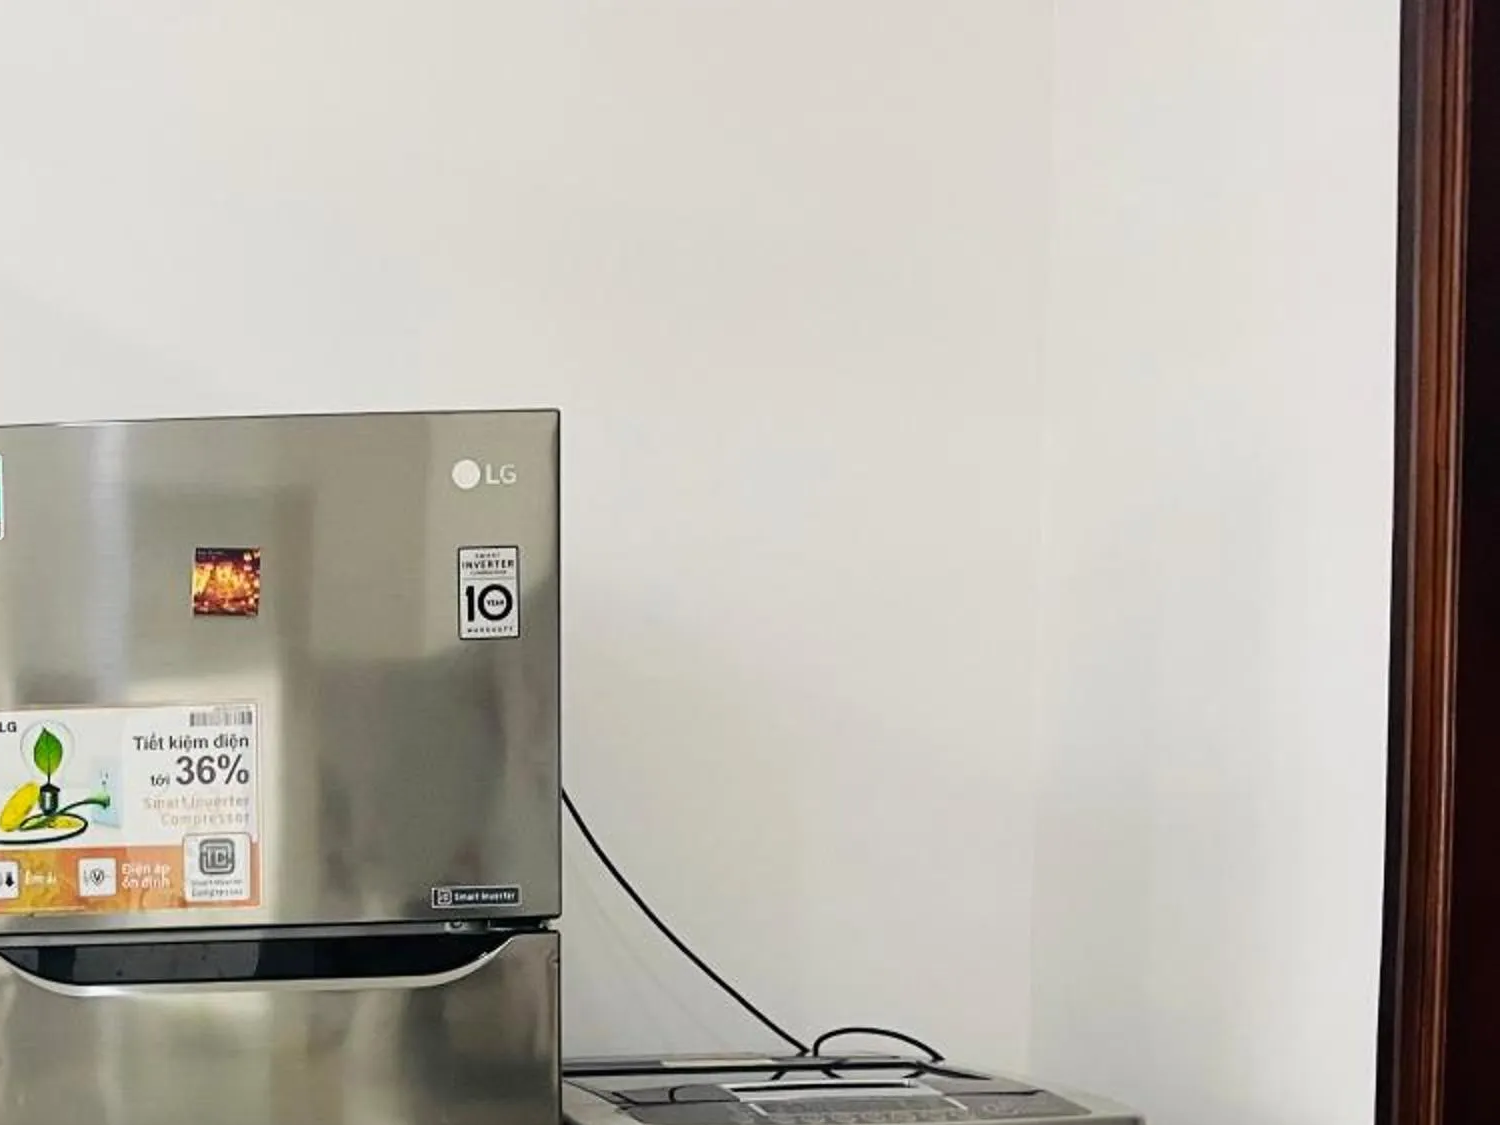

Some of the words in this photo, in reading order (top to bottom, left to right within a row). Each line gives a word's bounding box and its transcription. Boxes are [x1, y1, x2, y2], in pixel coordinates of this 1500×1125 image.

[485, 463, 517, 485] LG
[462, 559, 514, 570] INVERTER
[465, 583, 513, 622] 10
[132, 731, 164, 751] Tiết
[169, 735, 209, 752] kiệm
[213, 733, 250, 751] điện
[175, 753, 250, 785] 36%
